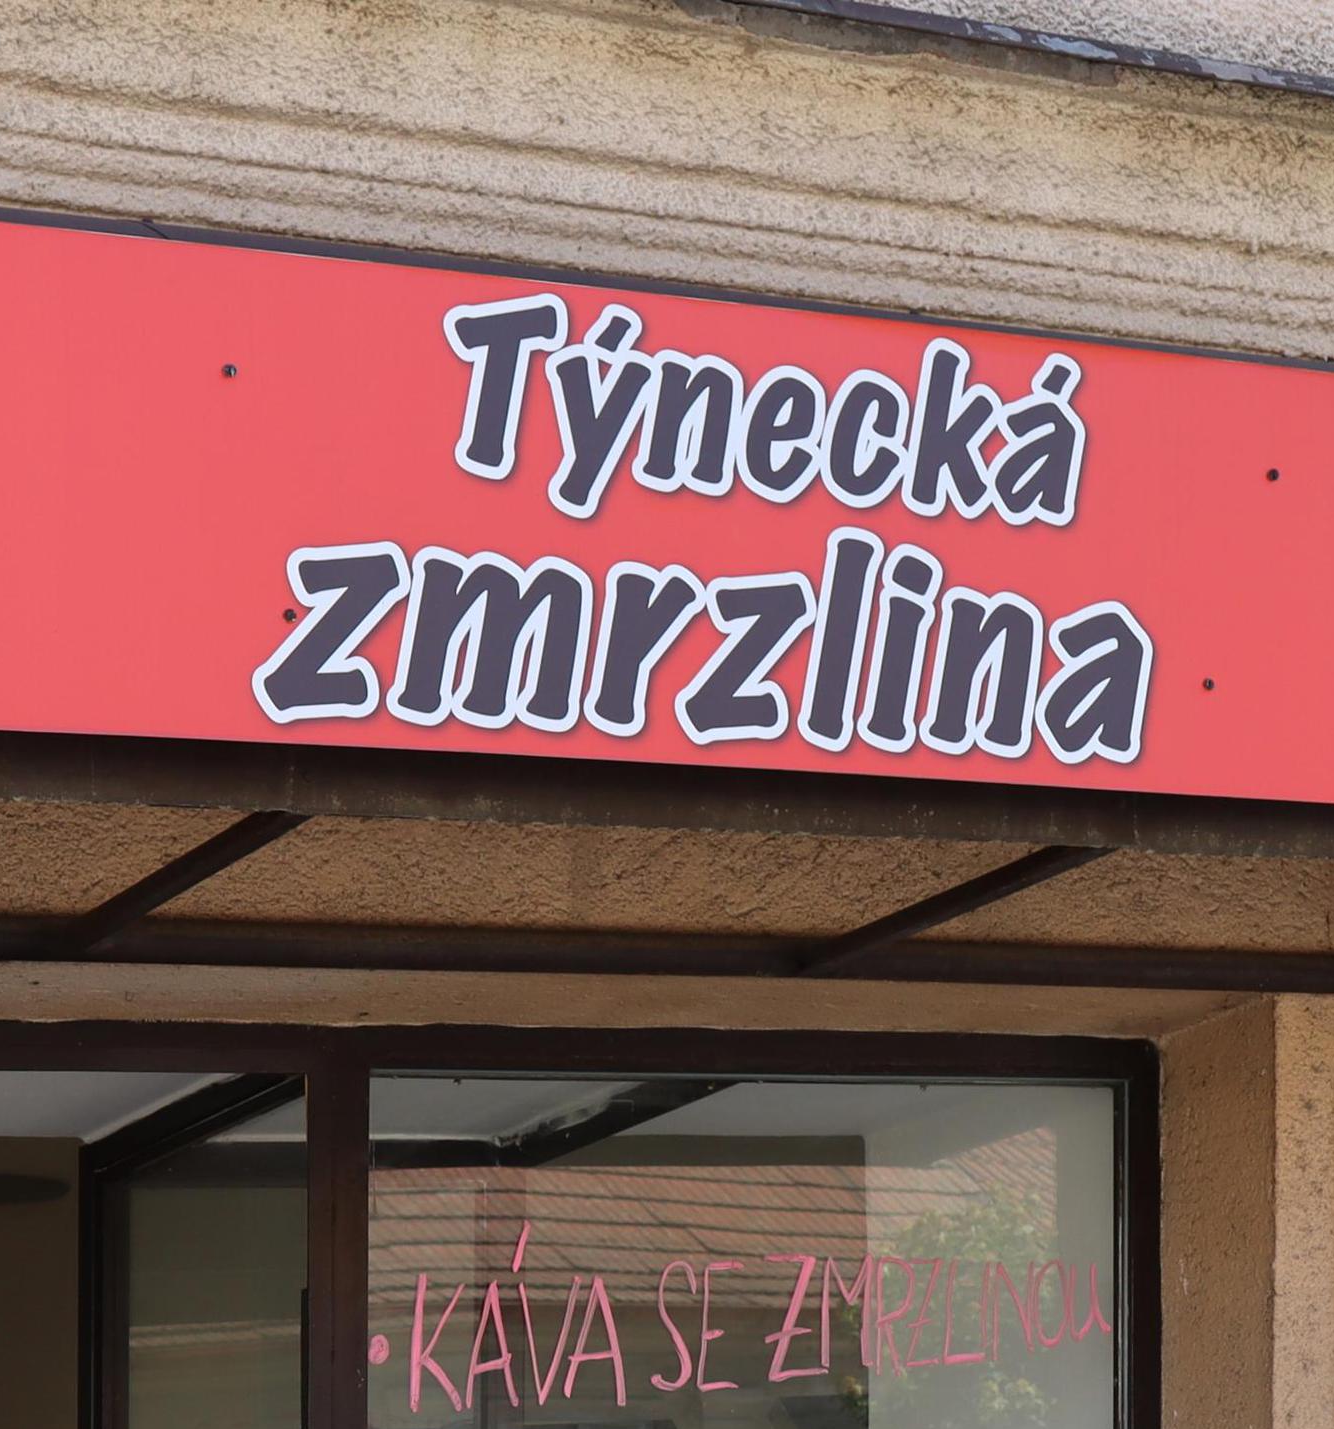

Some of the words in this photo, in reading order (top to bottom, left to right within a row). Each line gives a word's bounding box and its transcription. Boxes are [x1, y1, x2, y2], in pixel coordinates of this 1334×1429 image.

[444, 293, 1087, 526] Týnecká
[253, 527, 1153, 763] zmrzlina
[409, 1221, 627, 1413] KÁVA
[651, 1260, 743, 1392] SE
[764, 1252, 1112, 1382] ZMRZLINOU
